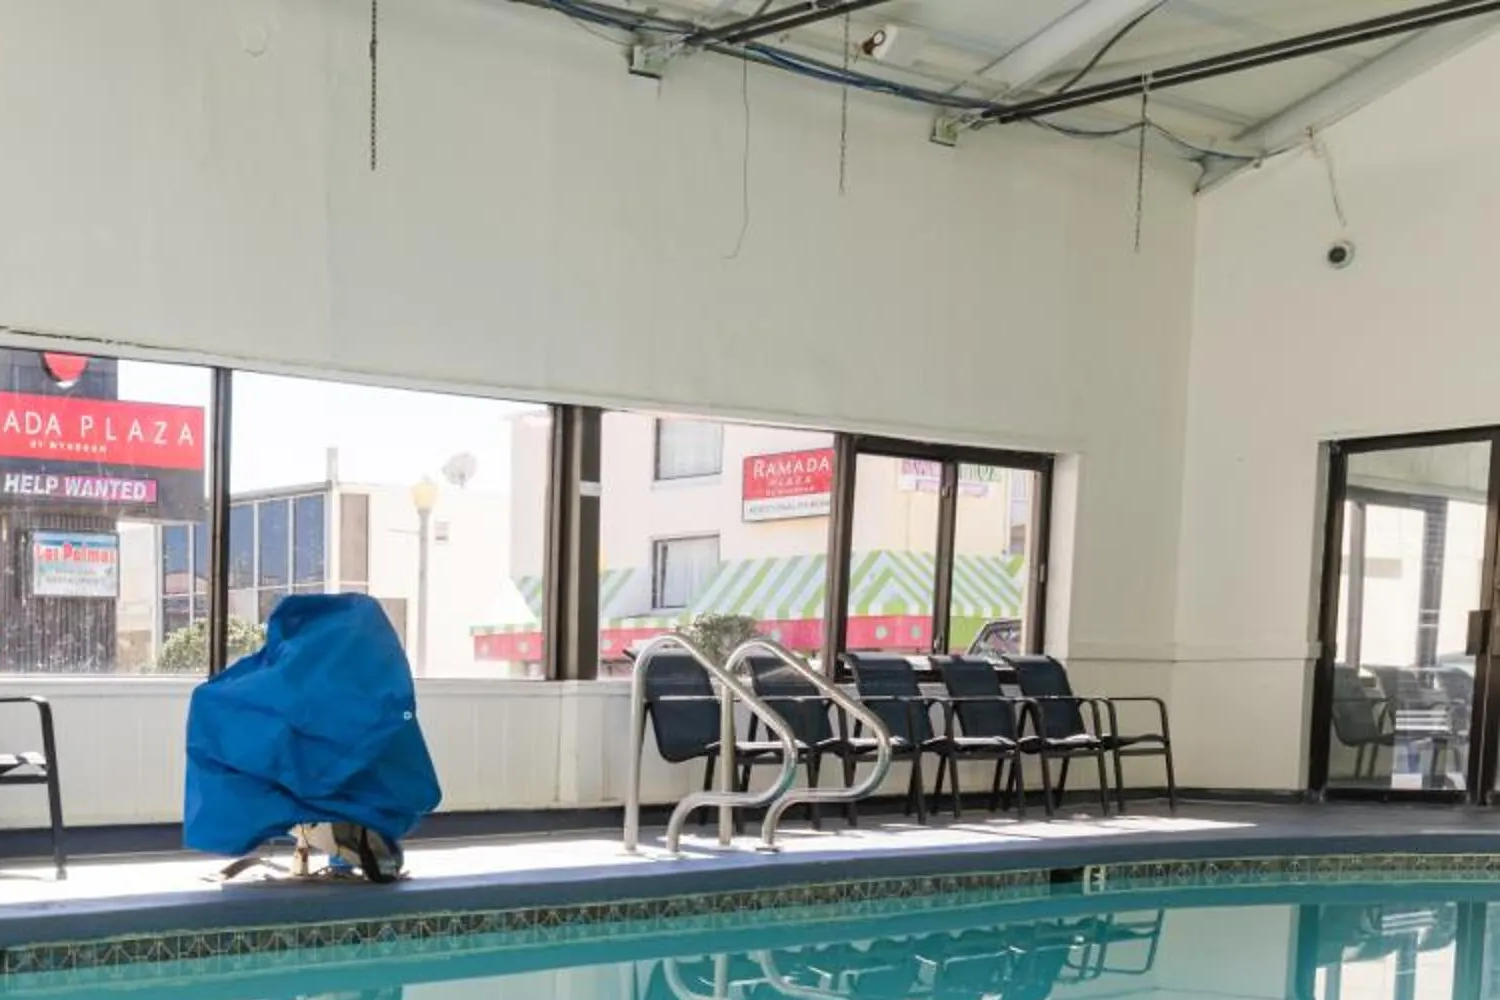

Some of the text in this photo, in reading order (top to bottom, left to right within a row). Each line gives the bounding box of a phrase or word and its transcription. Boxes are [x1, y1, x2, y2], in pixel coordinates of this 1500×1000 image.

[80, 415, 195, 446] PLAZA
[753, 456, 830, 479] RAMADA
[3, 473, 147, 500] HELP WANTED
